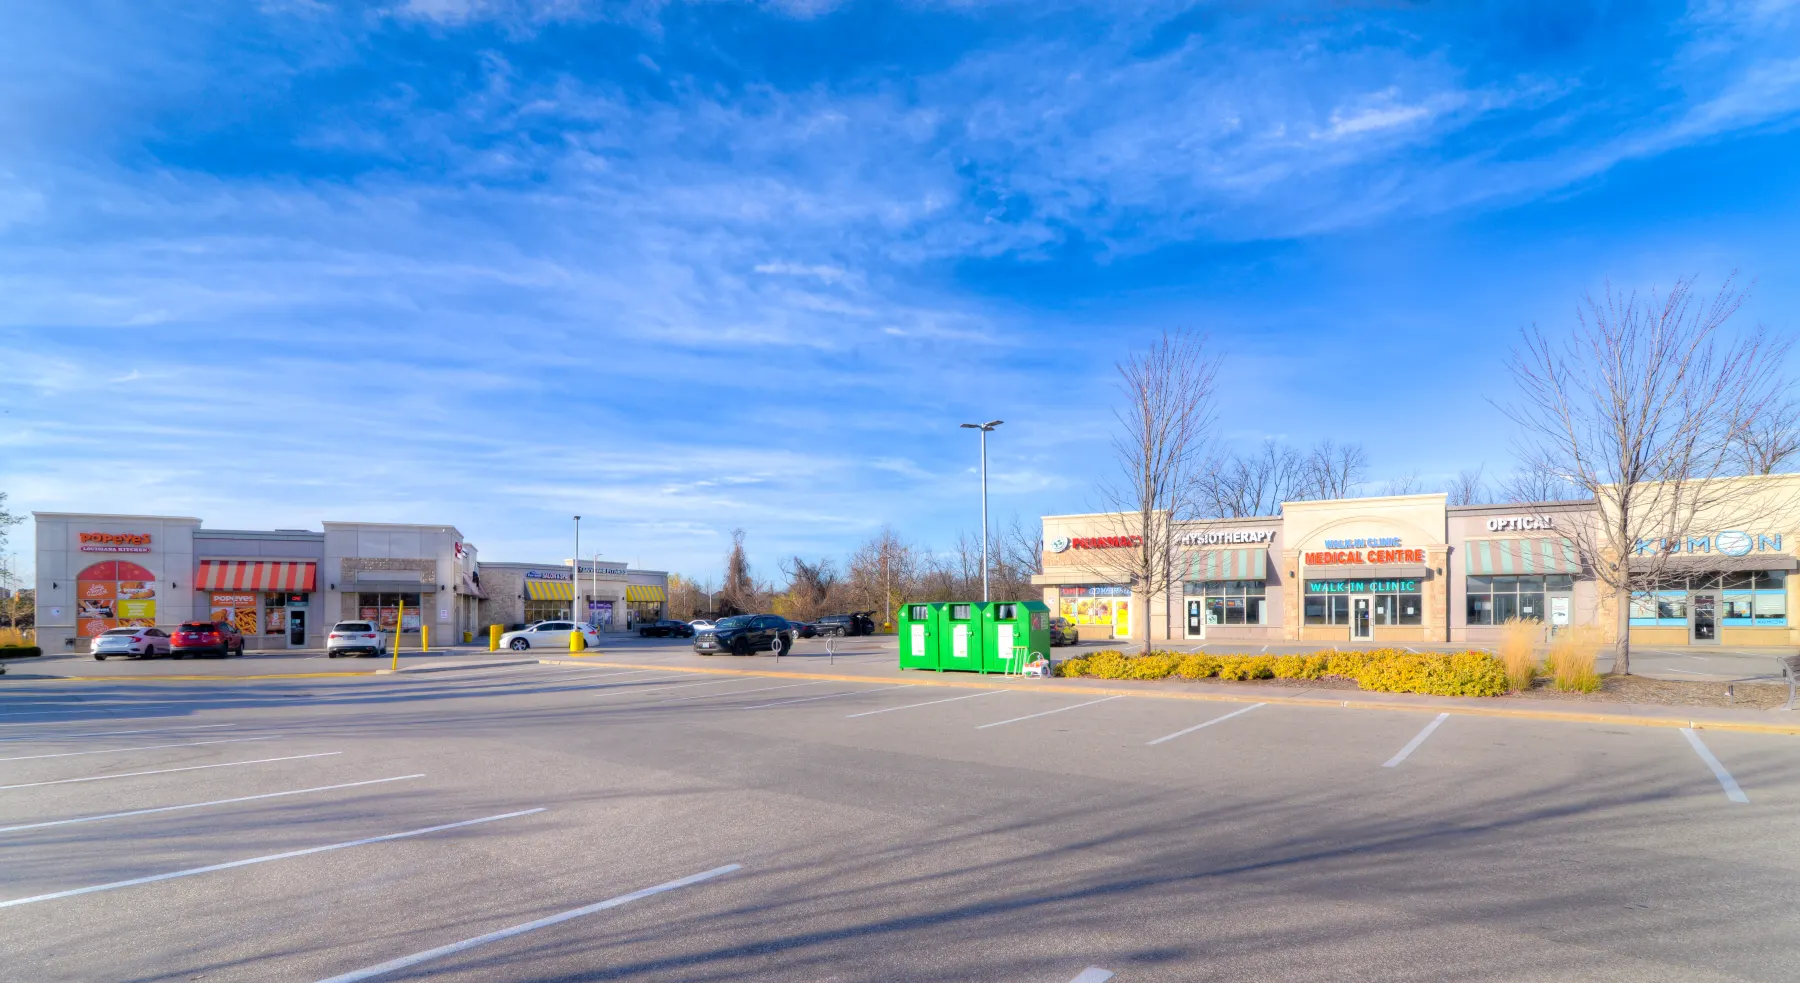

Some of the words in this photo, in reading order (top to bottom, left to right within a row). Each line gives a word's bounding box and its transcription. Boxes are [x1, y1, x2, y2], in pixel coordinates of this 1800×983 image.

[79, 533, 152, 546] POPEYES
[1325, 538, 1365, 549] WALK-IN
[1366, 536, 1401, 547] CLINIC
[1635, 530, 1782, 556] KUMON
[1304, 551, 1364, 565] MEDICAL
[1367, 549, 1424, 563] CENTRE
[1310, 582, 1364, 592] WALK-IN
[1370, 581, 1415, 591] CLINIC
